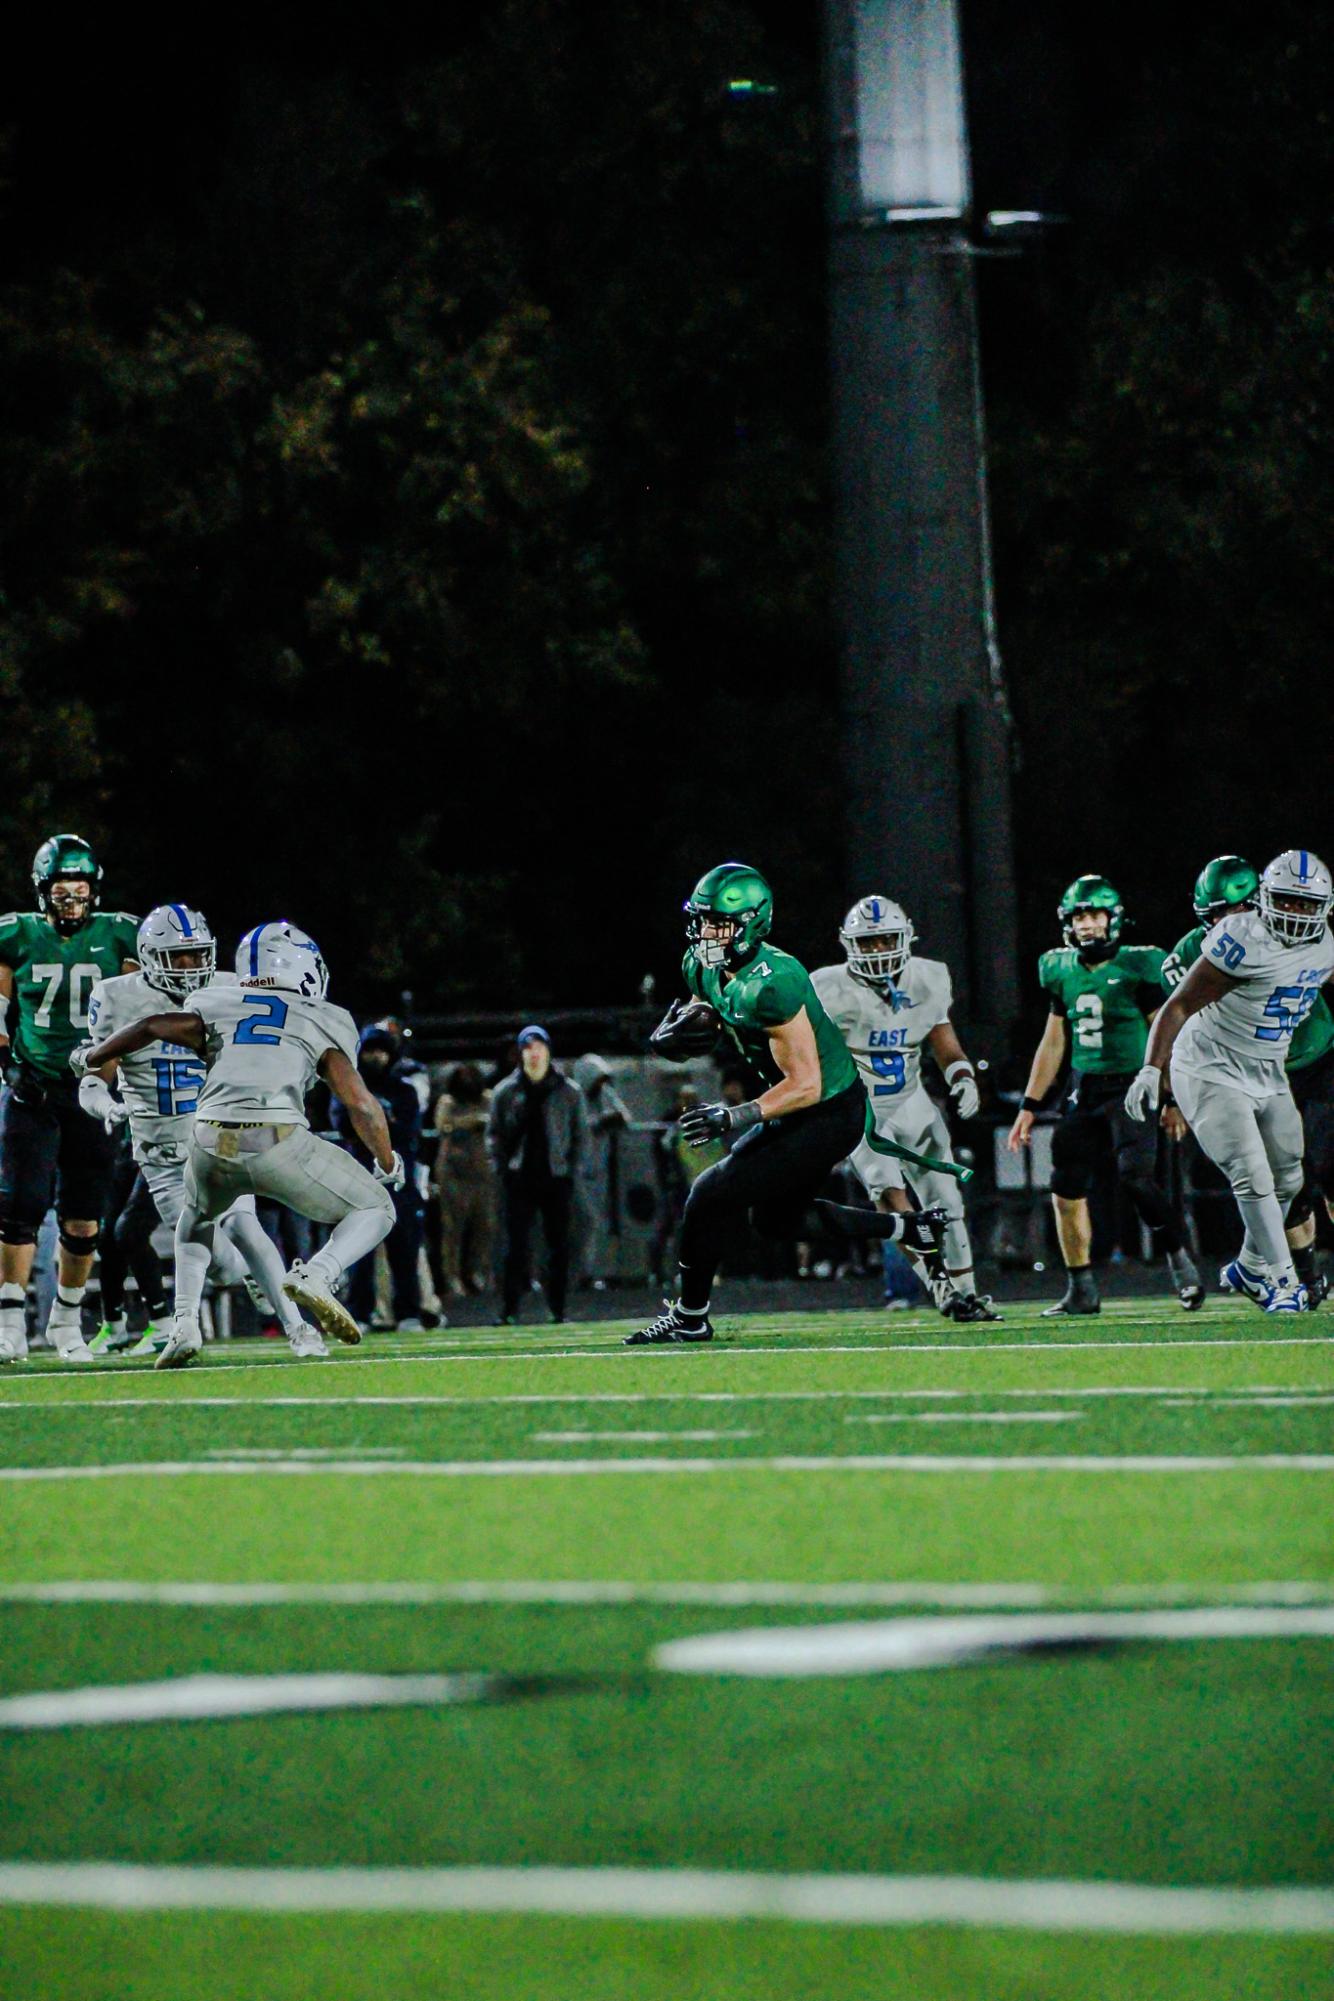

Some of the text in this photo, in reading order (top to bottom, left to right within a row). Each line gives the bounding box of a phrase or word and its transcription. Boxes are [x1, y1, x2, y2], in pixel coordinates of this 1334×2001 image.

[1211, 932, 1246, 971] 50
[32, 963, 102, 1028] 70
[232, 994, 289, 1046] 2
[1076, 994, 1104, 1048] 2
[868, 1028, 908, 1047] EAST
[151, 1059, 207, 1115] 15
[870, 1050, 906, 1096] 9
